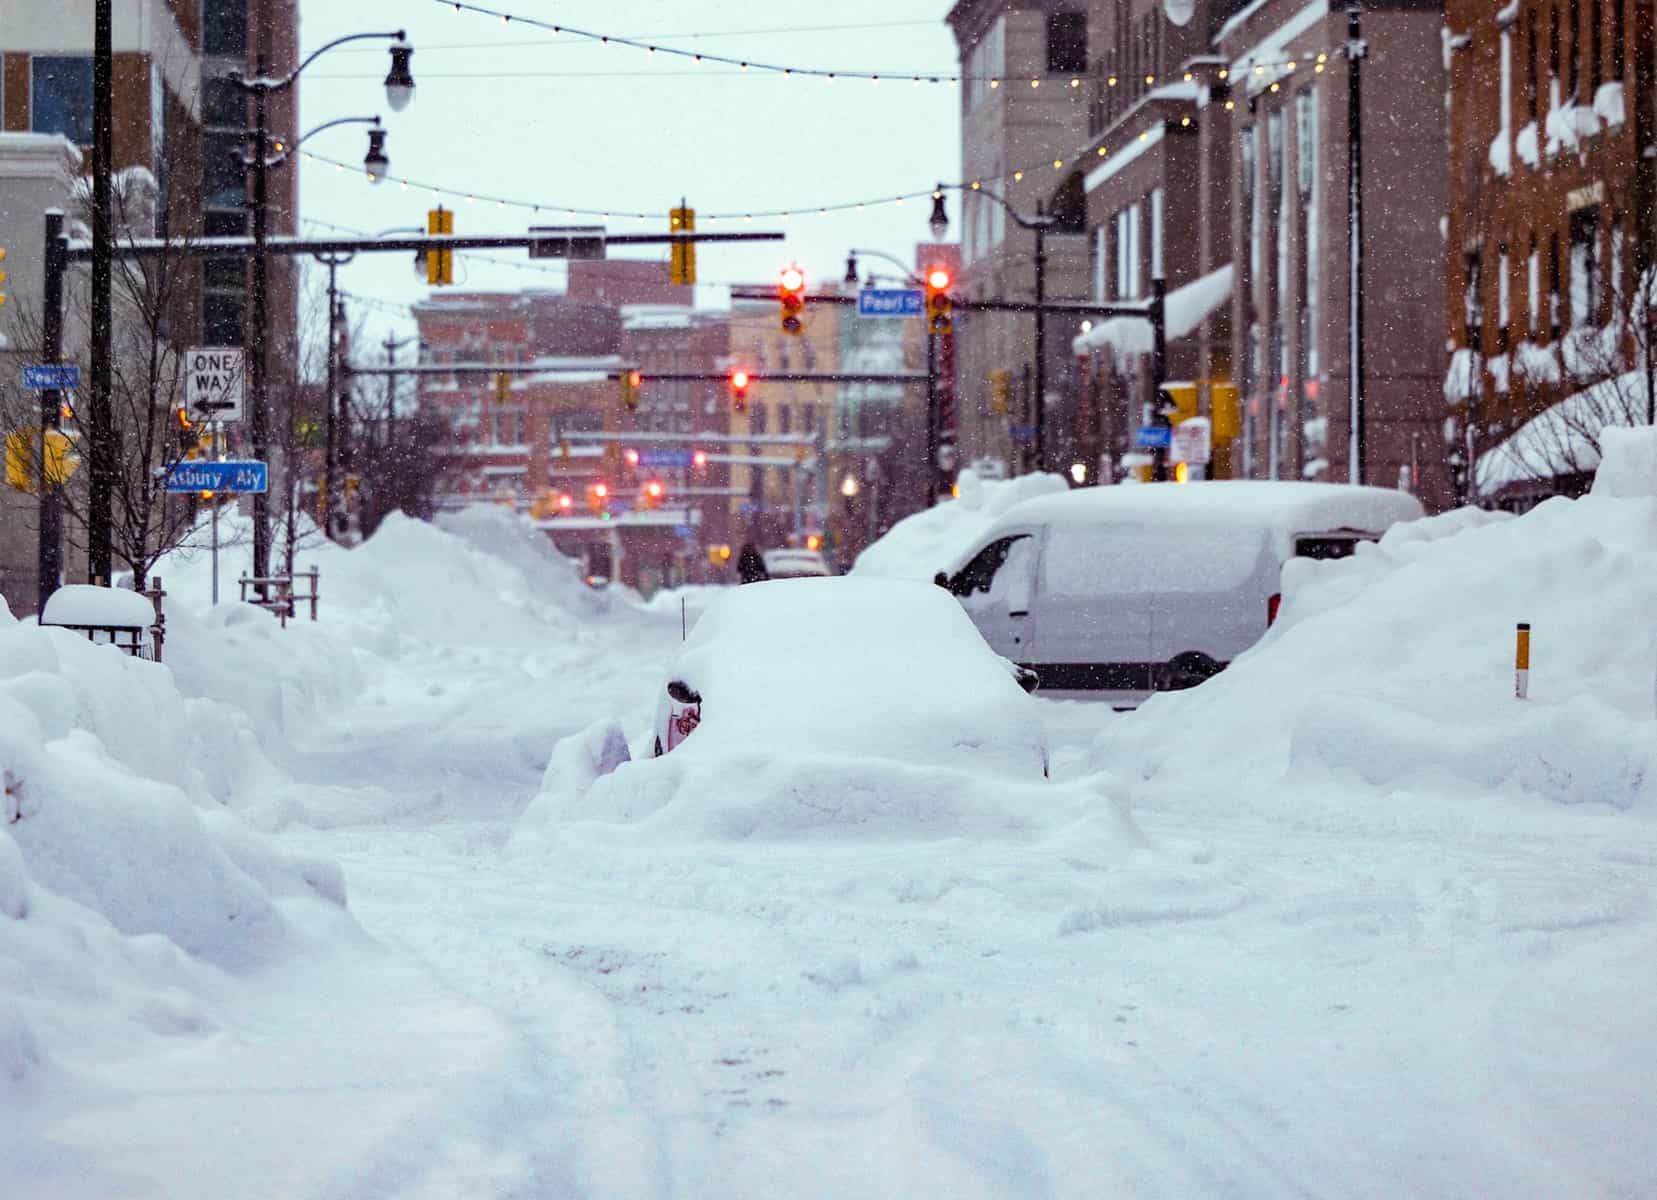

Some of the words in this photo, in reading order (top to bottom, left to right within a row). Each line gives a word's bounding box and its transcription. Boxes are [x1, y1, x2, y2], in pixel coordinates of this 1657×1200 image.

[195, 354, 233, 371] ONE
[195, 375, 235, 391] WAY
[168, 468, 223, 488] Asbury
[236, 468, 262, 490] Aly
